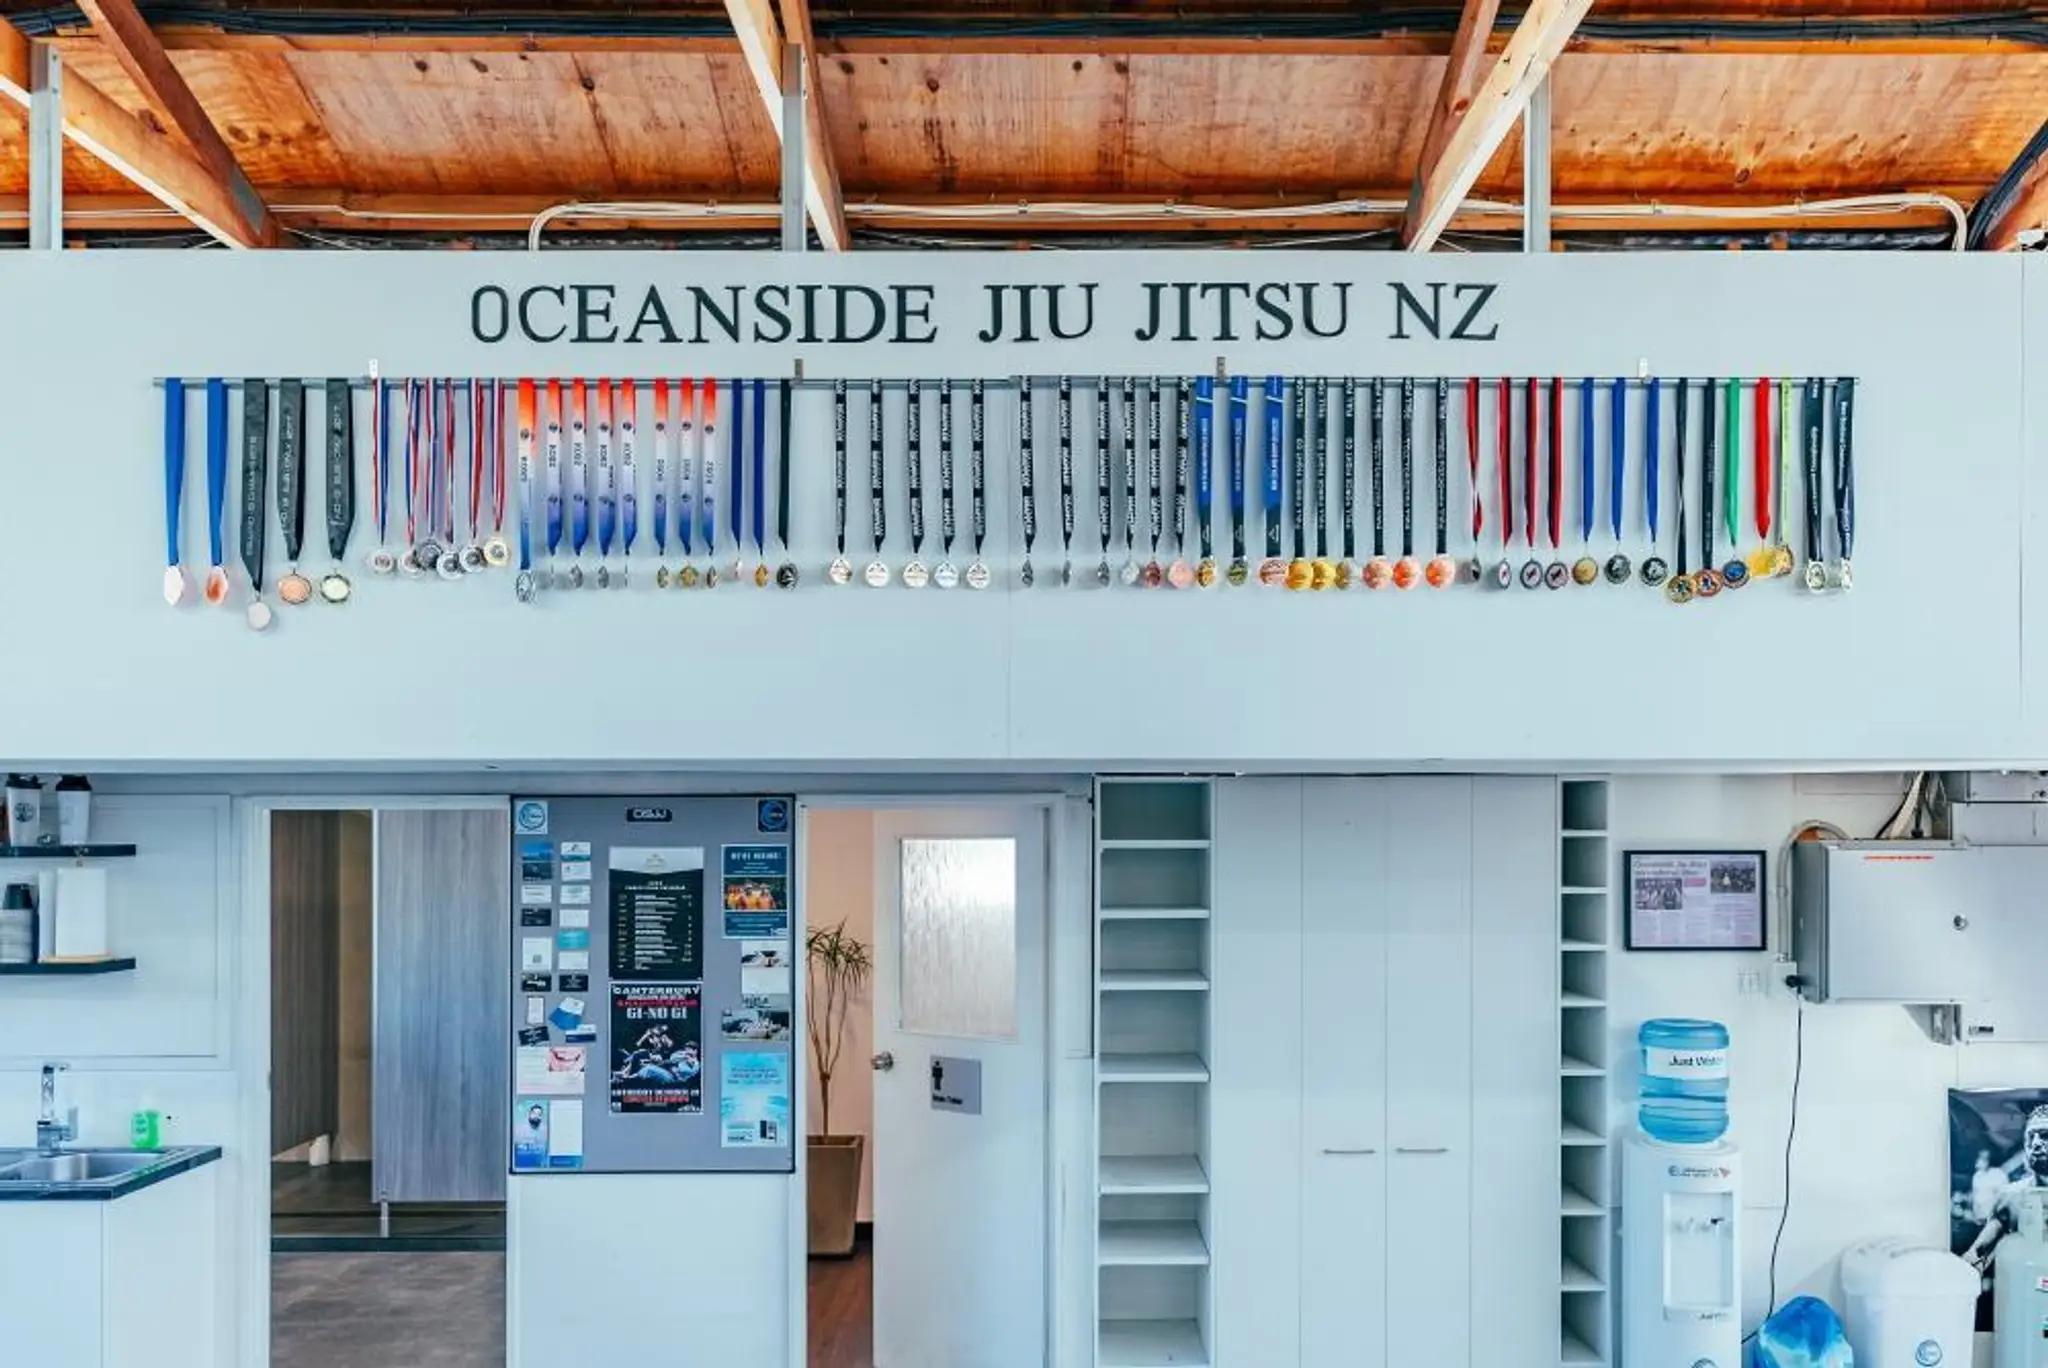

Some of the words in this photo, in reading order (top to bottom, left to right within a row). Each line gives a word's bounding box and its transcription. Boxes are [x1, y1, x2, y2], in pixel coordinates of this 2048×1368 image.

[470, 283, 938, 344] OCEANSIDE
[978, 283, 1099, 343] JIU
[1134, 282, 1353, 342] JITSU
[1387, 281, 1500, 341] NZ
[613, 986, 700, 995] CANTERBURY
[626, 1007, 668, 1019] GI-NO
[671, 1007, 687, 1019] GI
[1668, 1055, 1693, 1066] Just
